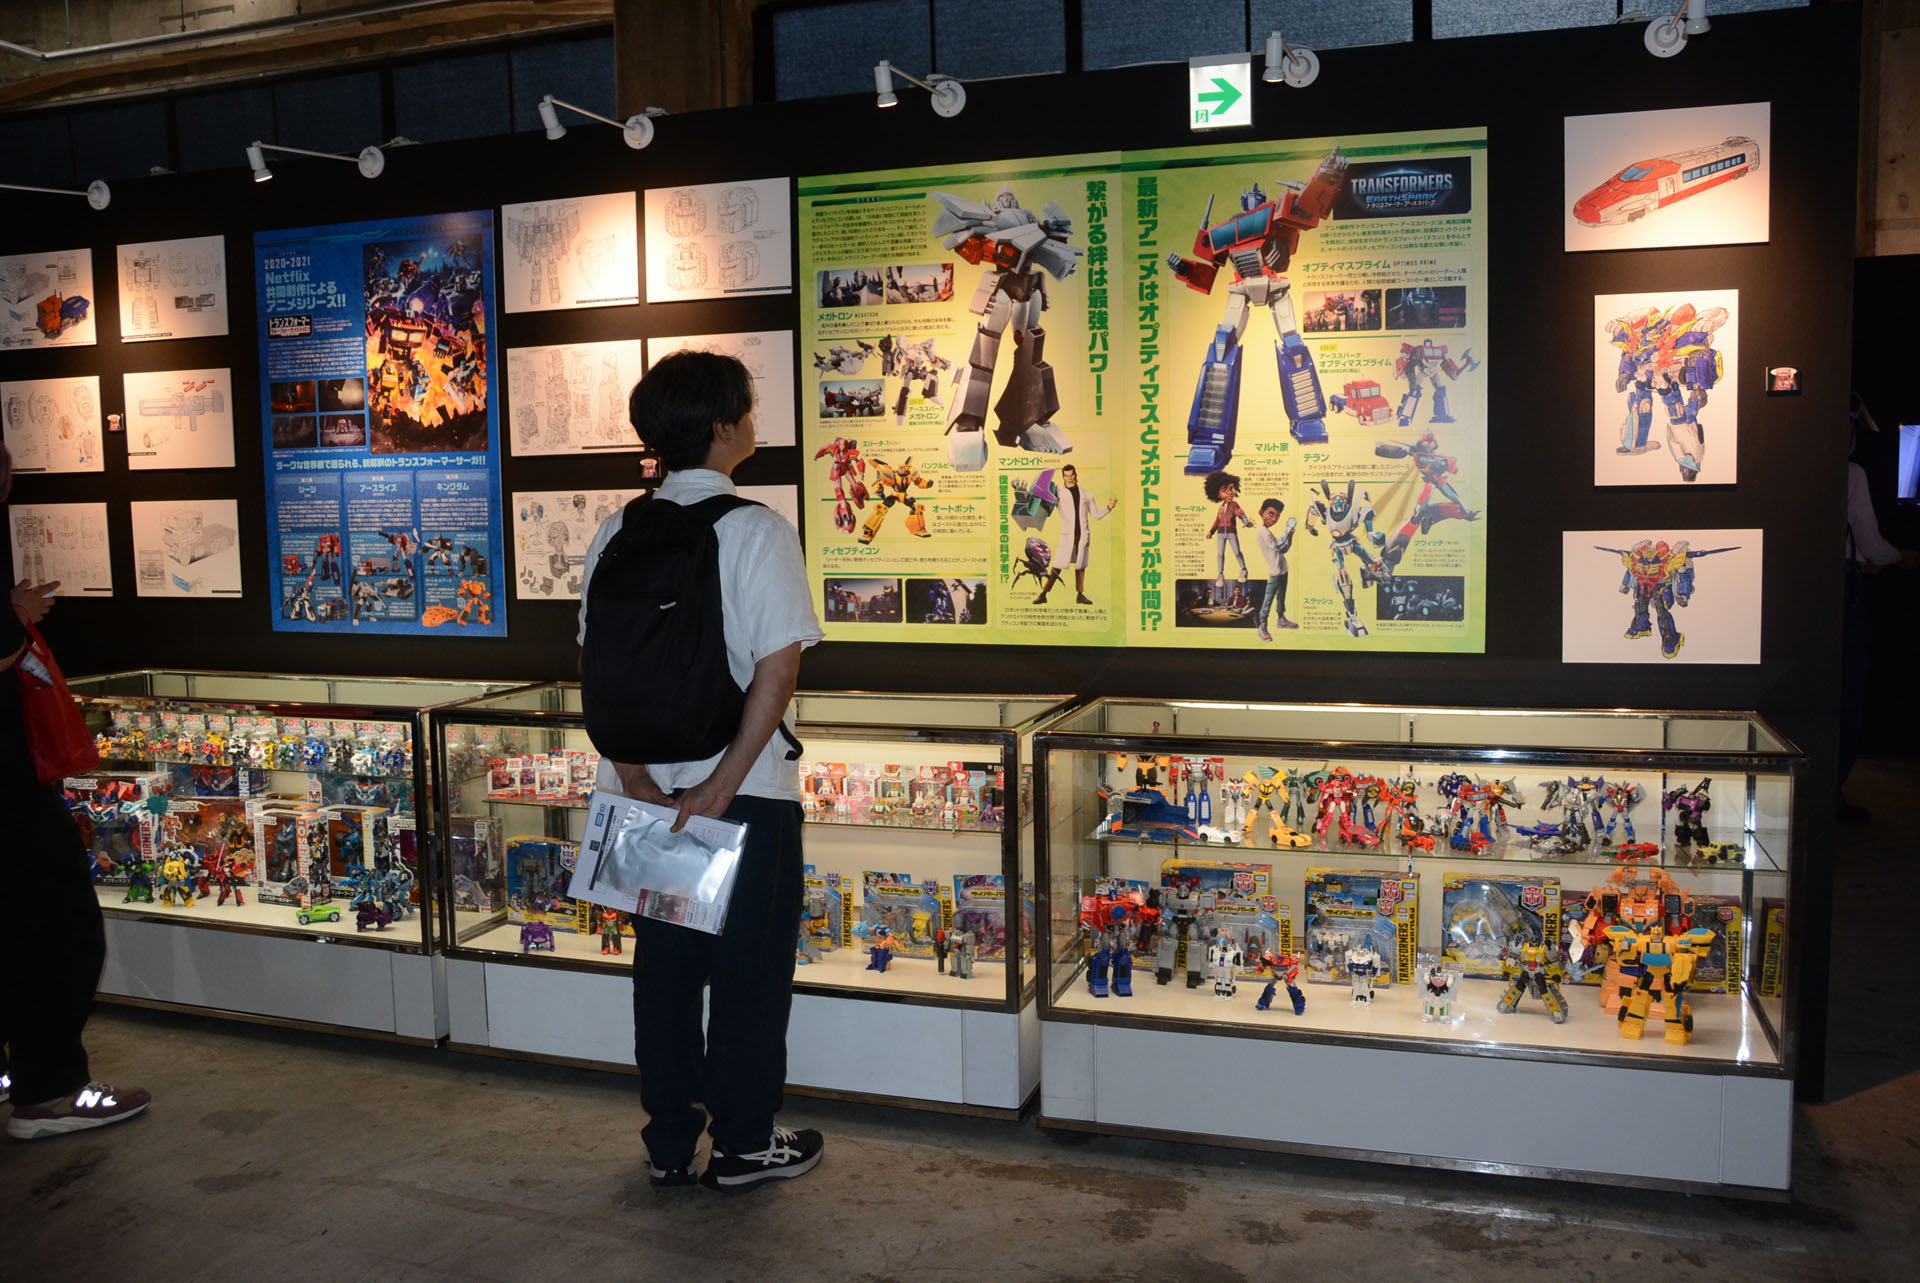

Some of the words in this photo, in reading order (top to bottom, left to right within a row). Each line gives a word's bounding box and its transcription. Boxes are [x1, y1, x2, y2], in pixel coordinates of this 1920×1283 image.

[1351, 173, 1453, 195] TRANSFORMERS
[1302, 260, 1391, 272] オプティマスプライム
[265, 271, 310, 284] Netflix
[818, 312, 853, 321] メガトロン
[999, 456, 1044, 466] マンドロイド
[1303, 453, 1330, 462] テラン
[822, 546, 880, 556] ディセプティコン
[143, 820, 153, 861] FORMERS
[843, 892, 852, 947] TRANSFORMERS
[943, 900, 952, 931] FORMERS
[1281, 919, 1291, 958] SFORMERS
[1398, 922, 1409, 982] TRANSFORMERS
[1728, 930, 1740, 993] TRANSFORMERS
